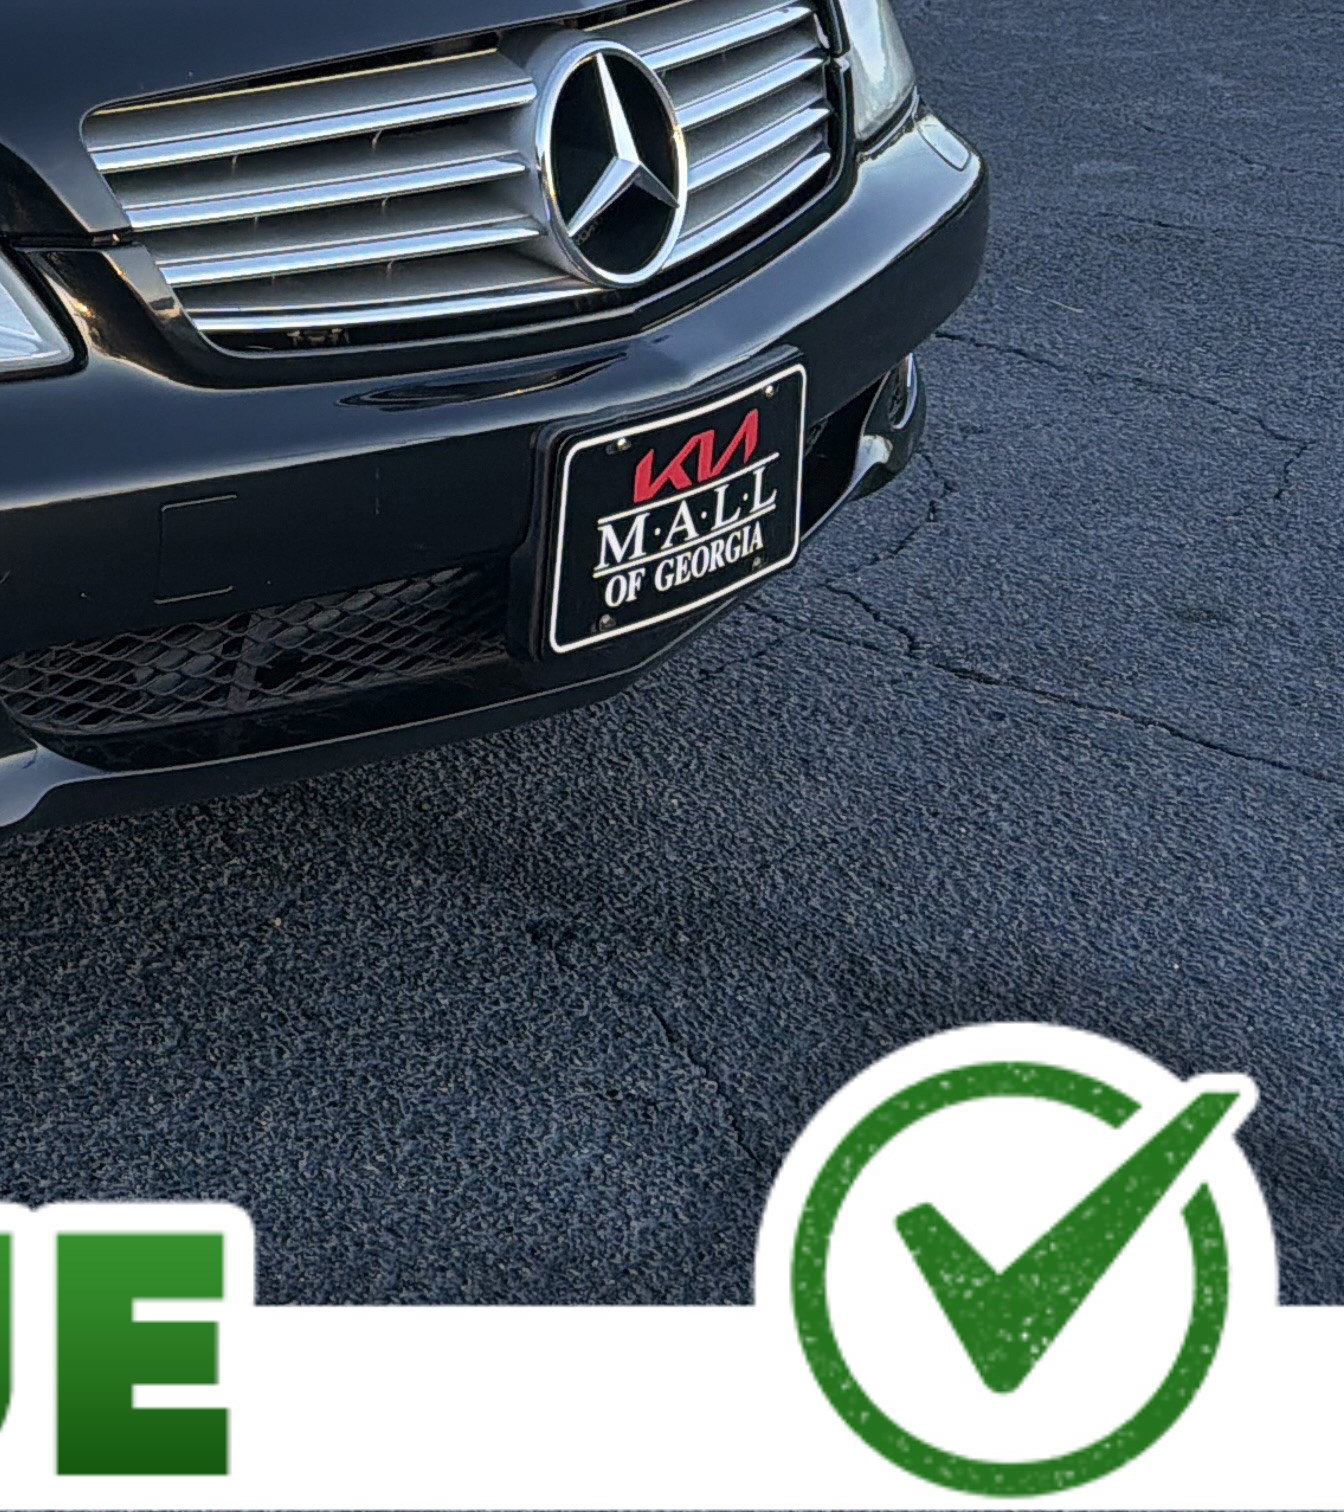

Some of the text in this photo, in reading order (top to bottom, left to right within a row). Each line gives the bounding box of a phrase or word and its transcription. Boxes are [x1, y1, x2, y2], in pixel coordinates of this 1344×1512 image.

[633, 408, 759, 504] KIA
[604, 520, 764, 607] OF GEORGIA
